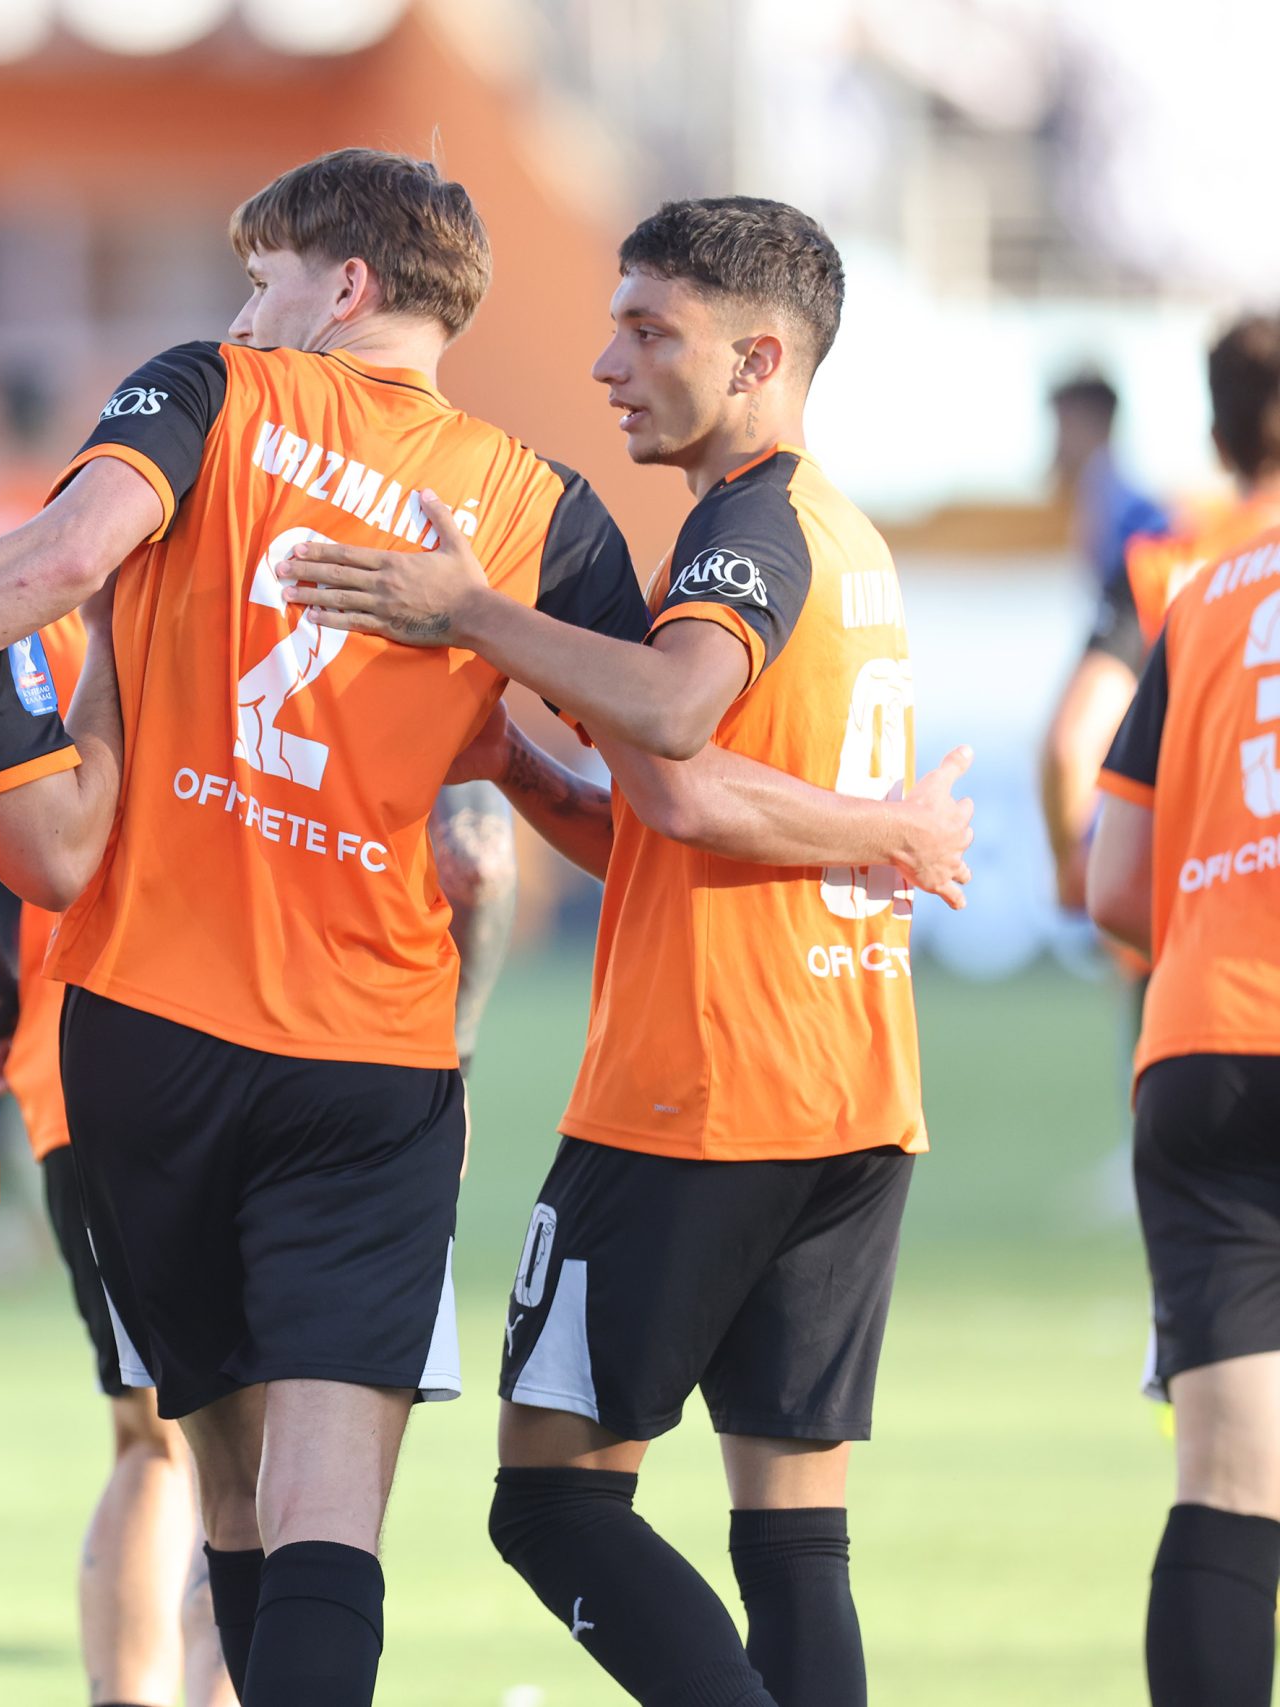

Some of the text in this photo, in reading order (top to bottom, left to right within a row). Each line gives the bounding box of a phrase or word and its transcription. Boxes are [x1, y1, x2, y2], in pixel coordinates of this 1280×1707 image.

[233, 527, 351, 791] 2
[337, 831, 388, 873] FC
[1179, 850, 1233, 893] OFI
